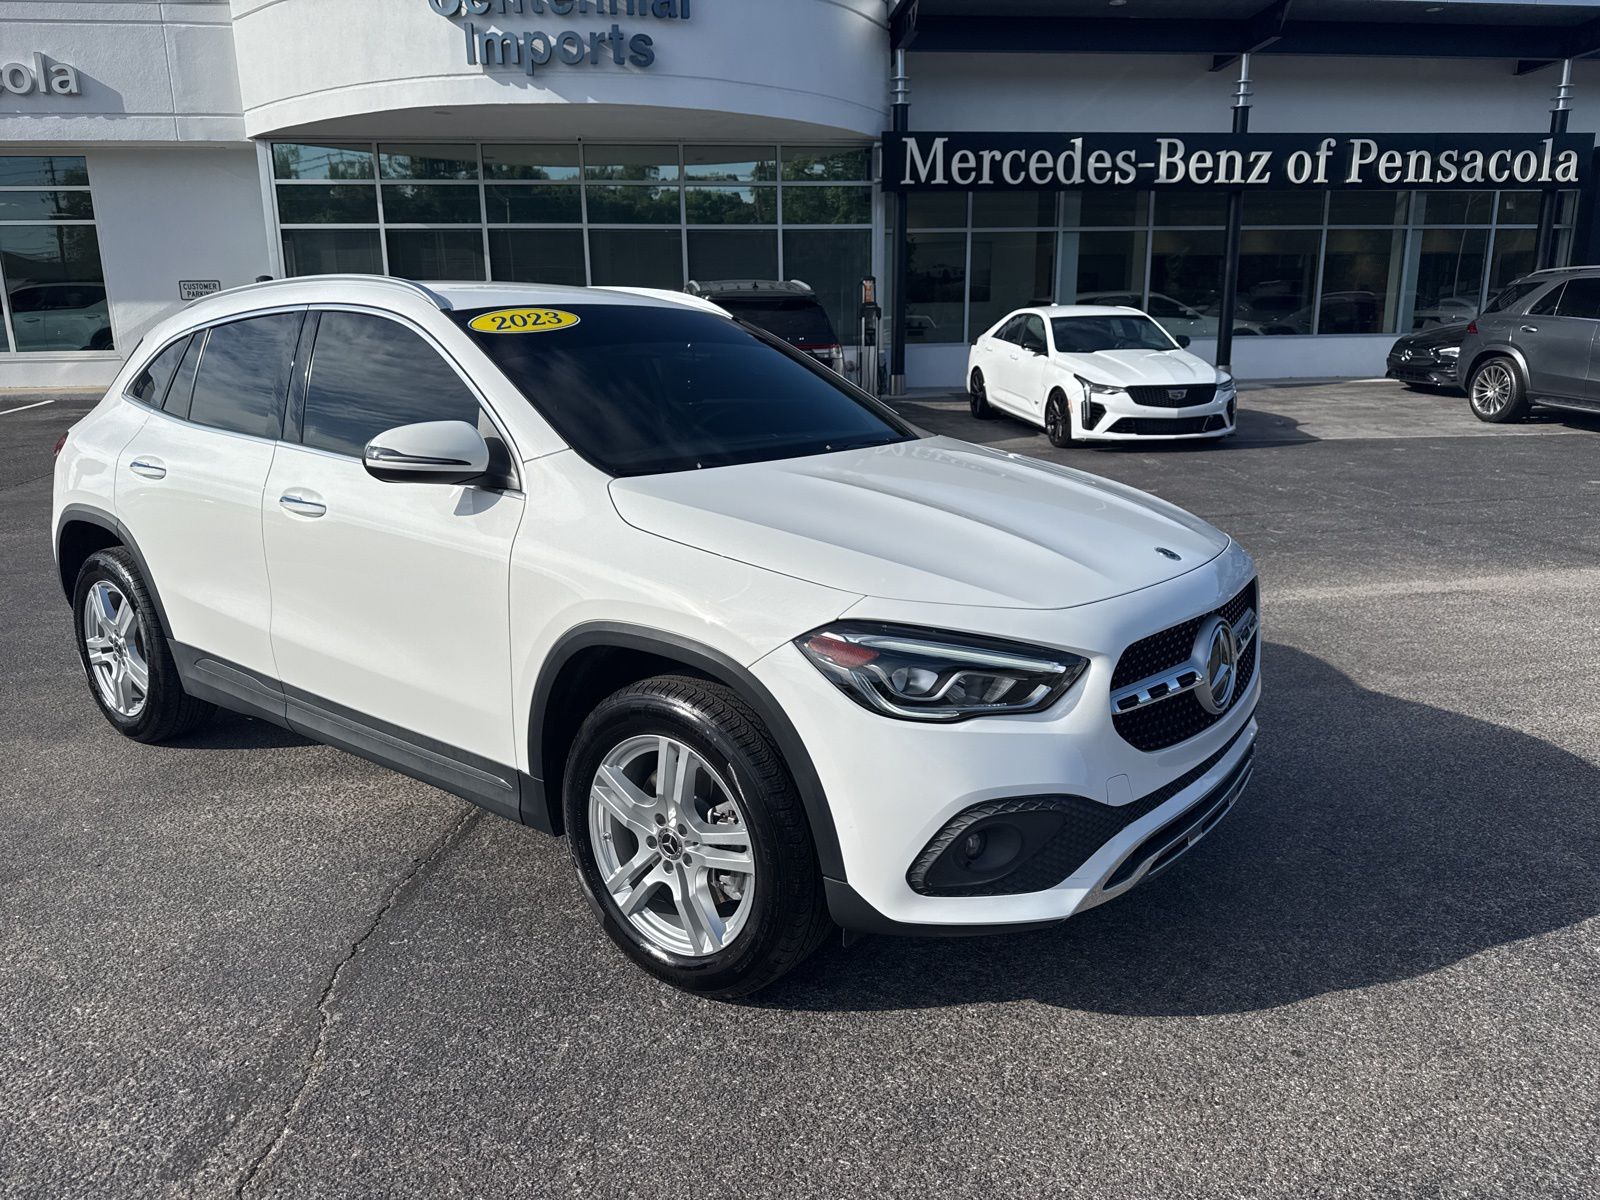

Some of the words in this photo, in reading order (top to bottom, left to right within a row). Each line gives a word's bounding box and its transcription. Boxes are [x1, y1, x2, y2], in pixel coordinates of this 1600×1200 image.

[464, 22, 655, 76] Imports
[0, 51, 80, 95] ola
[900, 137, 1272, 185] Mercedes-Benz
[1287, 138, 1337, 184] of
[1345, 138, 1579, 184] Pensacola
[490, 311, 563, 331] 2023
